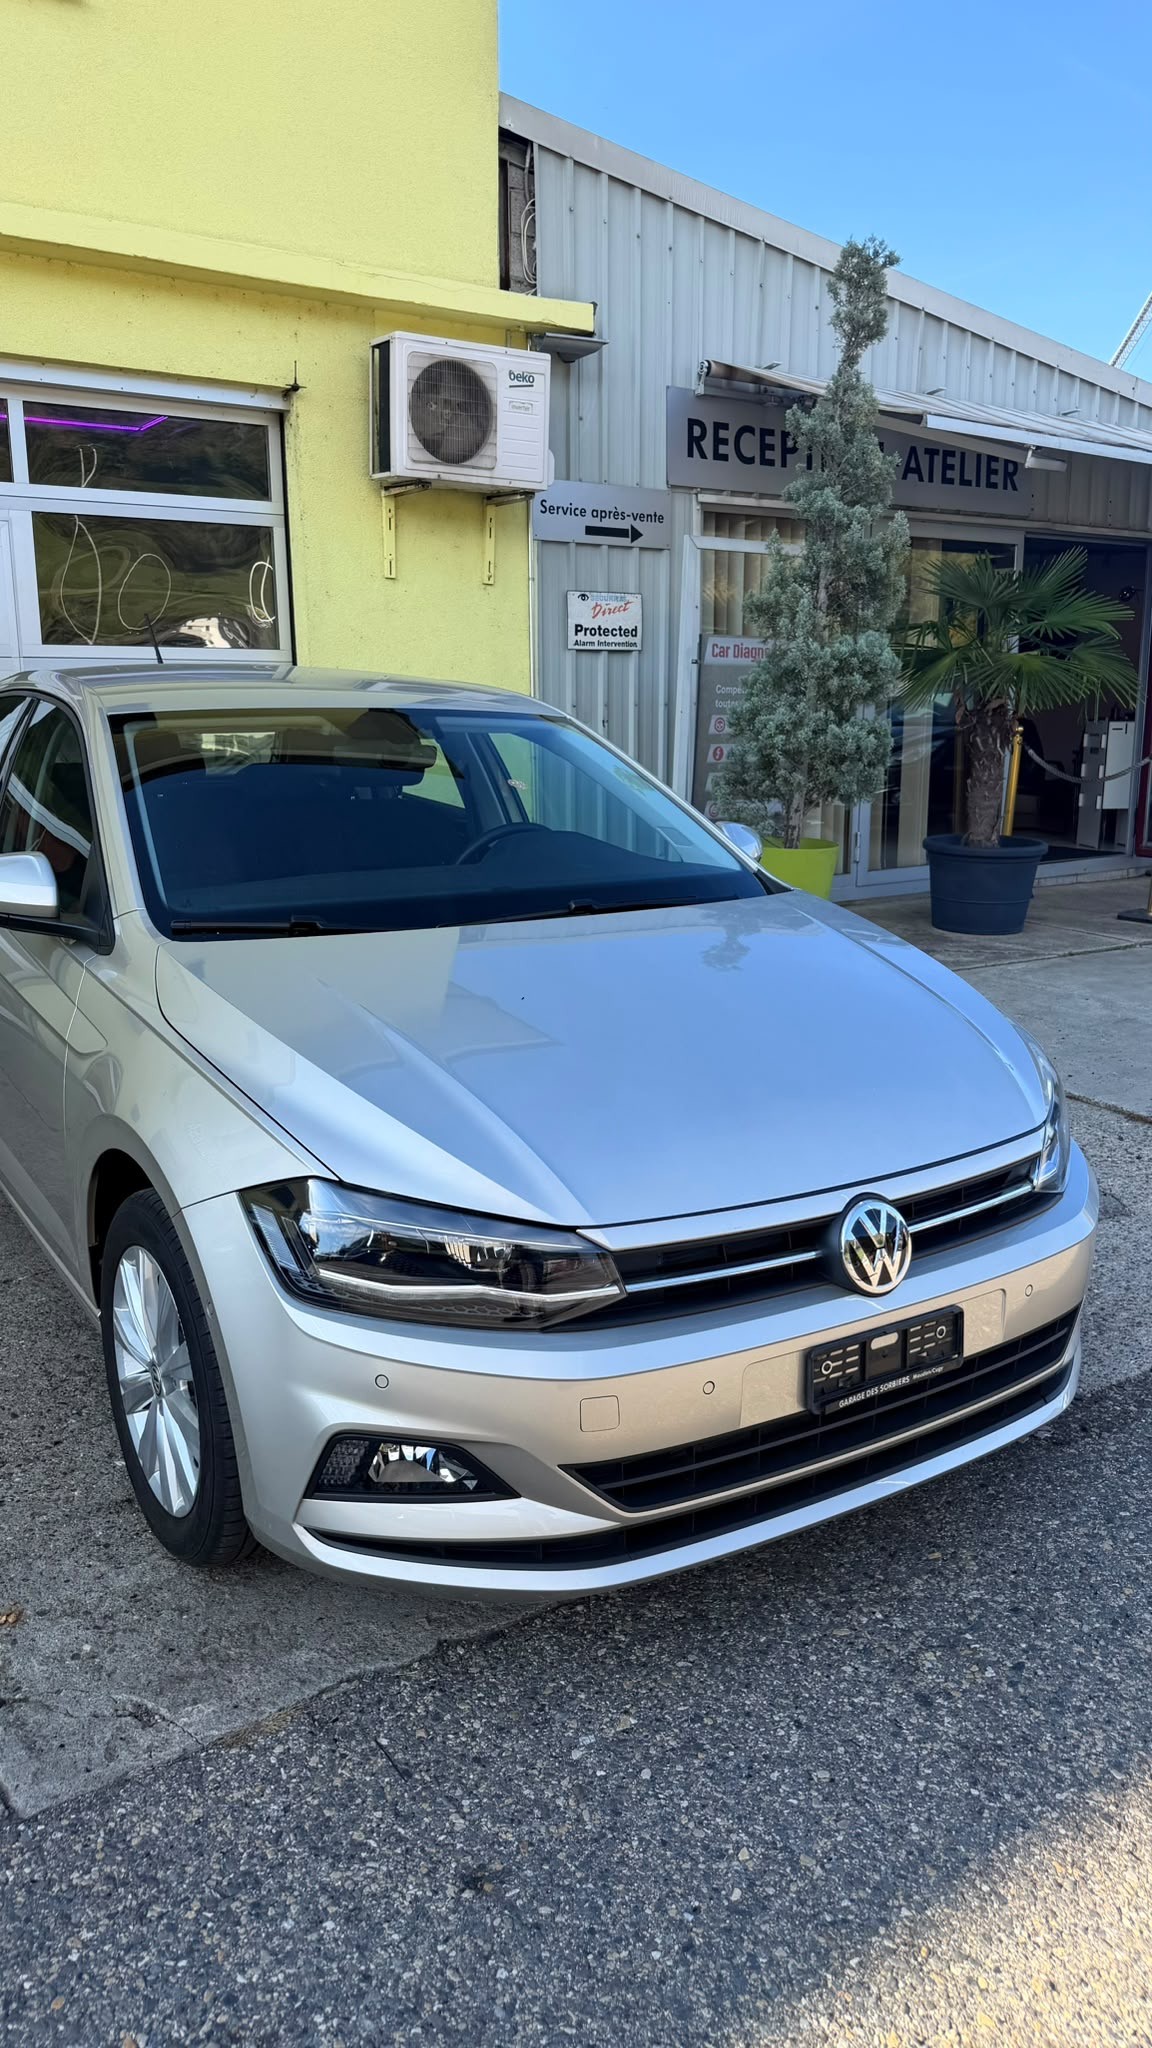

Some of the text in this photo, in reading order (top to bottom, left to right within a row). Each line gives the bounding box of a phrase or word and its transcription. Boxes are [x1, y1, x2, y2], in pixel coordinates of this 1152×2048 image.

[508, 369, 535, 384] beko
[901, 445, 1019, 491] ATELIER
[540, 499, 665, 524] Service après-vente
[591, 600, 634, 619] Direct
[574, 623, 638, 638] Protected
[573, 639, 638, 648] Alarm Intervention
[711, 643, 730, 658] Car
[838, 1391, 865, 1408] GARAGE
[866, 1386, 879, 1398] DES
[879, 1375, 910, 1392] SORBIERS
